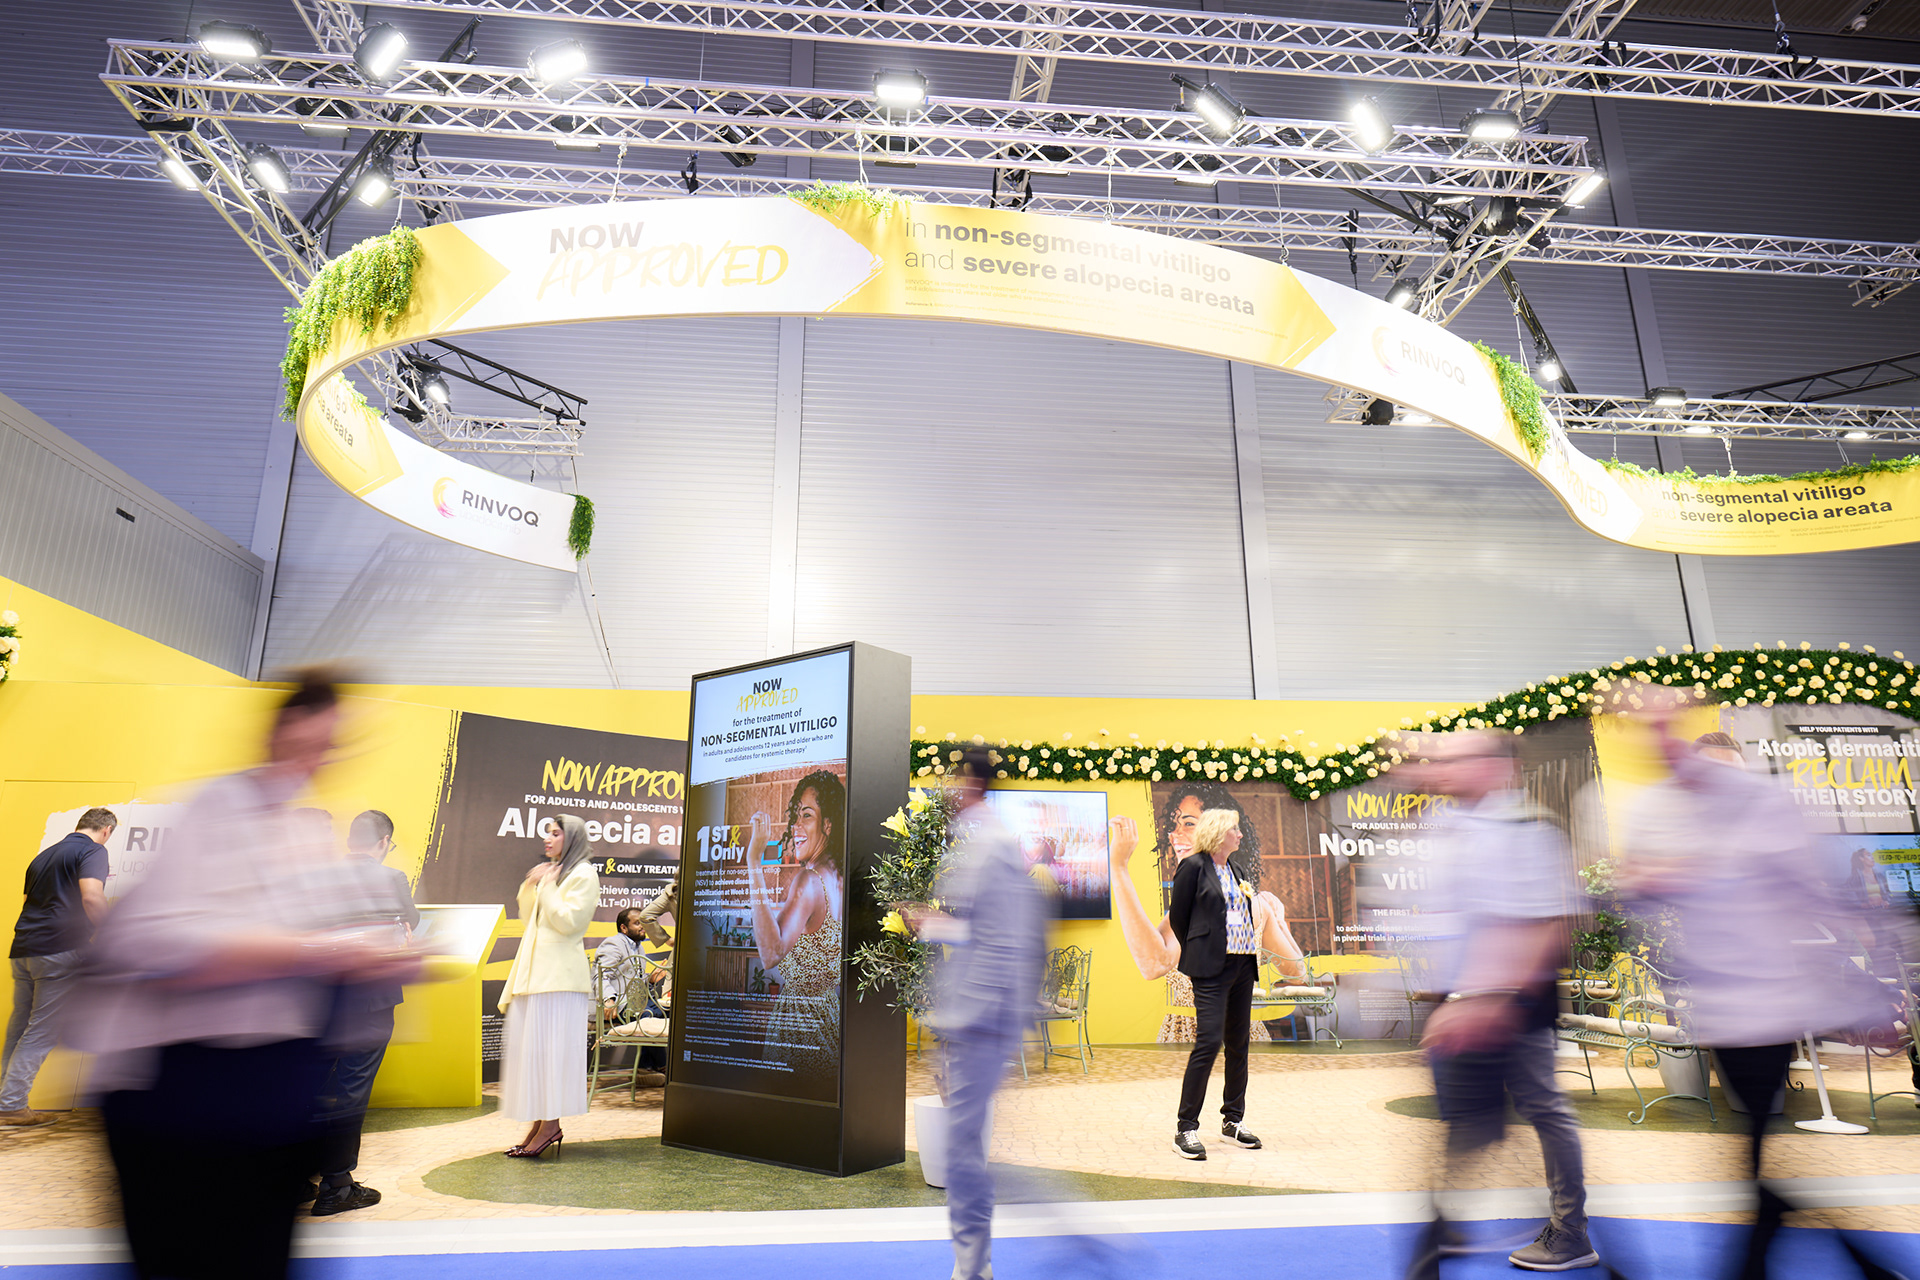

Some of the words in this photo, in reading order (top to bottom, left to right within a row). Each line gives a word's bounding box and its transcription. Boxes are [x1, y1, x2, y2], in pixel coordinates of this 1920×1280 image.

[549, 221, 644, 254] NOW
[905, 217, 927, 239] in
[935, 220, 1140, 264] non-segmental
[1149, 247, 1231, 284] vitiligo
[536, 240, 789, 300] APPROVED
[905, 248, 955, 272] and
[963, 256, 1058, 281] severe
[1063, 264, 1175, 299] alopecia
[1180, 286, 1256, 316] areata
[1401, 340, 1467, 387] RINVOQ
[325, 408, 354, 448] areata
[1662, 490, 1789, 507] non-segmental
[1792, 483, 1866, 501] vitiligo
[1680, 509, 1733, 523] severe
[1738, 507, 1818, 525] alopecia
[1823, 499, 1893, 519] areata
[753, 678, 782, 694] NOW
[736, 688, 798, 712] APPROVED
[732, 718, 743, 727] for
[744, 716, 756, 725] the
[756, 711, 792, 723] treatment
[794, 708, 802, 718] of
[701, 724, 786, 747] NON-SEGMENTAL
[790, 716, 837, 734] VITILIGO
[708, 748, 723, 756] adults
[734, 744, 764, 754] adolescents
[771, 741, 785, 750] years
[786, 738, 796, 746] and
[797, 736, 810, 744] older
[725, 754, 752, 762] candidates
[761, 750, 784, 760] systemic
[1758, 738, 1826, 759] Atopic
[541, 756, 601, 793] NOW
[1786, 757, 1913, 791] RECLAIM
[525, 794, 546, 805] FOR
[547, 796, 586, 808] ADULTS
[587, 798, 609, 810] AND
[610, 800, 678, 814] ADOLESCENTS
[1347, 790, 1391, 819] NOW
[1789, 789, 1850, 806] THEIR
[1853, 788, 1917, 806] STORY
[497, 807, 651, 846] Aloecia
[728, 824, 741, 848] &
[1352, 822, 1368, 830] FOR
[1369, 822, 1400, 830] ADULTS
[1400, 822, 1418, 830] AND
[711, 843, 745, 863] Only
[605, 858, 616, 874] &
[617, 864, 643, 874] ONLY
[632, 898, 641, 908] in
[1372, 908, 1389, 916] THE
[1390, 908, 1410, 916] FIRST
[1333, 934, 1341, 942] in
[1342, 934, 1367, 943] pivotal
[1367, 934, 1386, 942] trials
